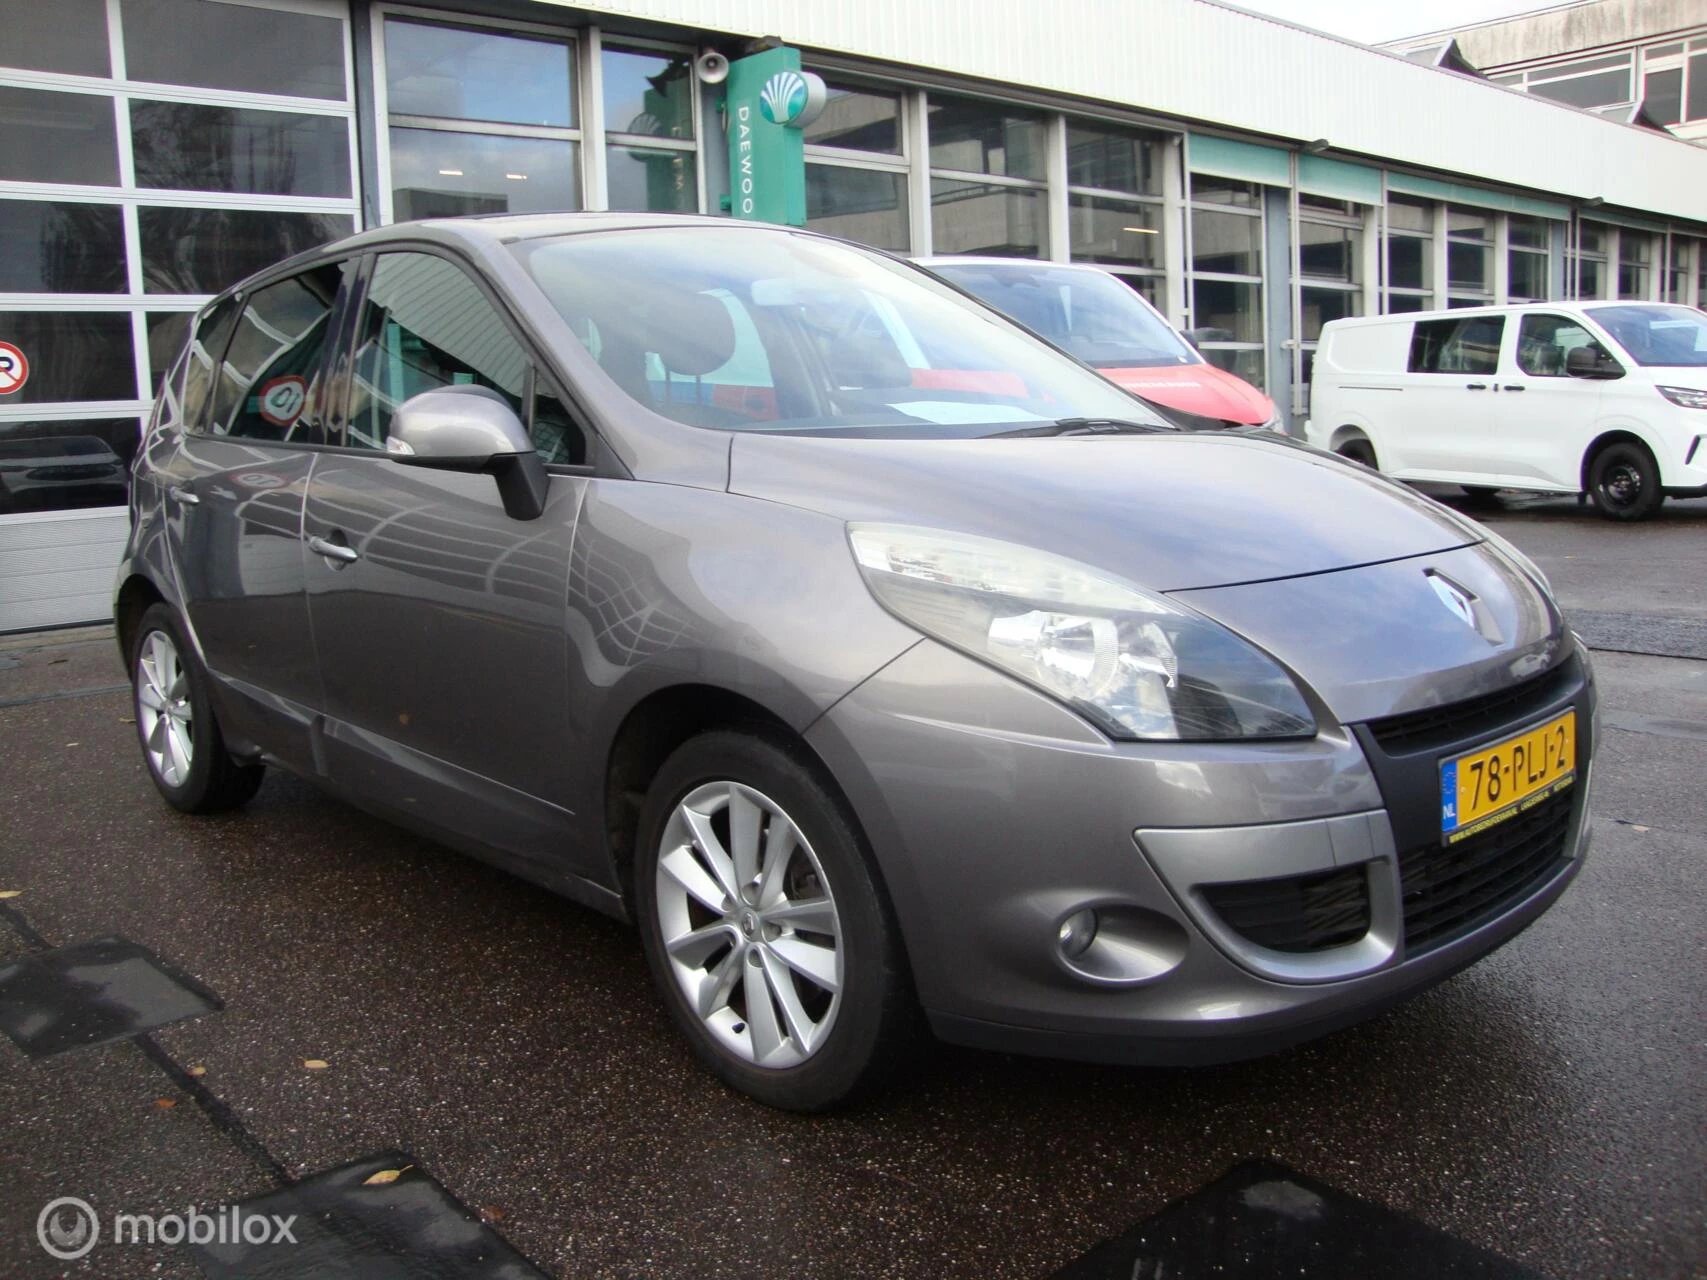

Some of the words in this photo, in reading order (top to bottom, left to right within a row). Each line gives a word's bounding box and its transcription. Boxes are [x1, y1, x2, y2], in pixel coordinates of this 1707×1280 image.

[738, 106, 754, 214] DAEWOO
[1442, 802, 1456, 819] NL
[1470, 725, 1566, 812] 78-PLJ-2
